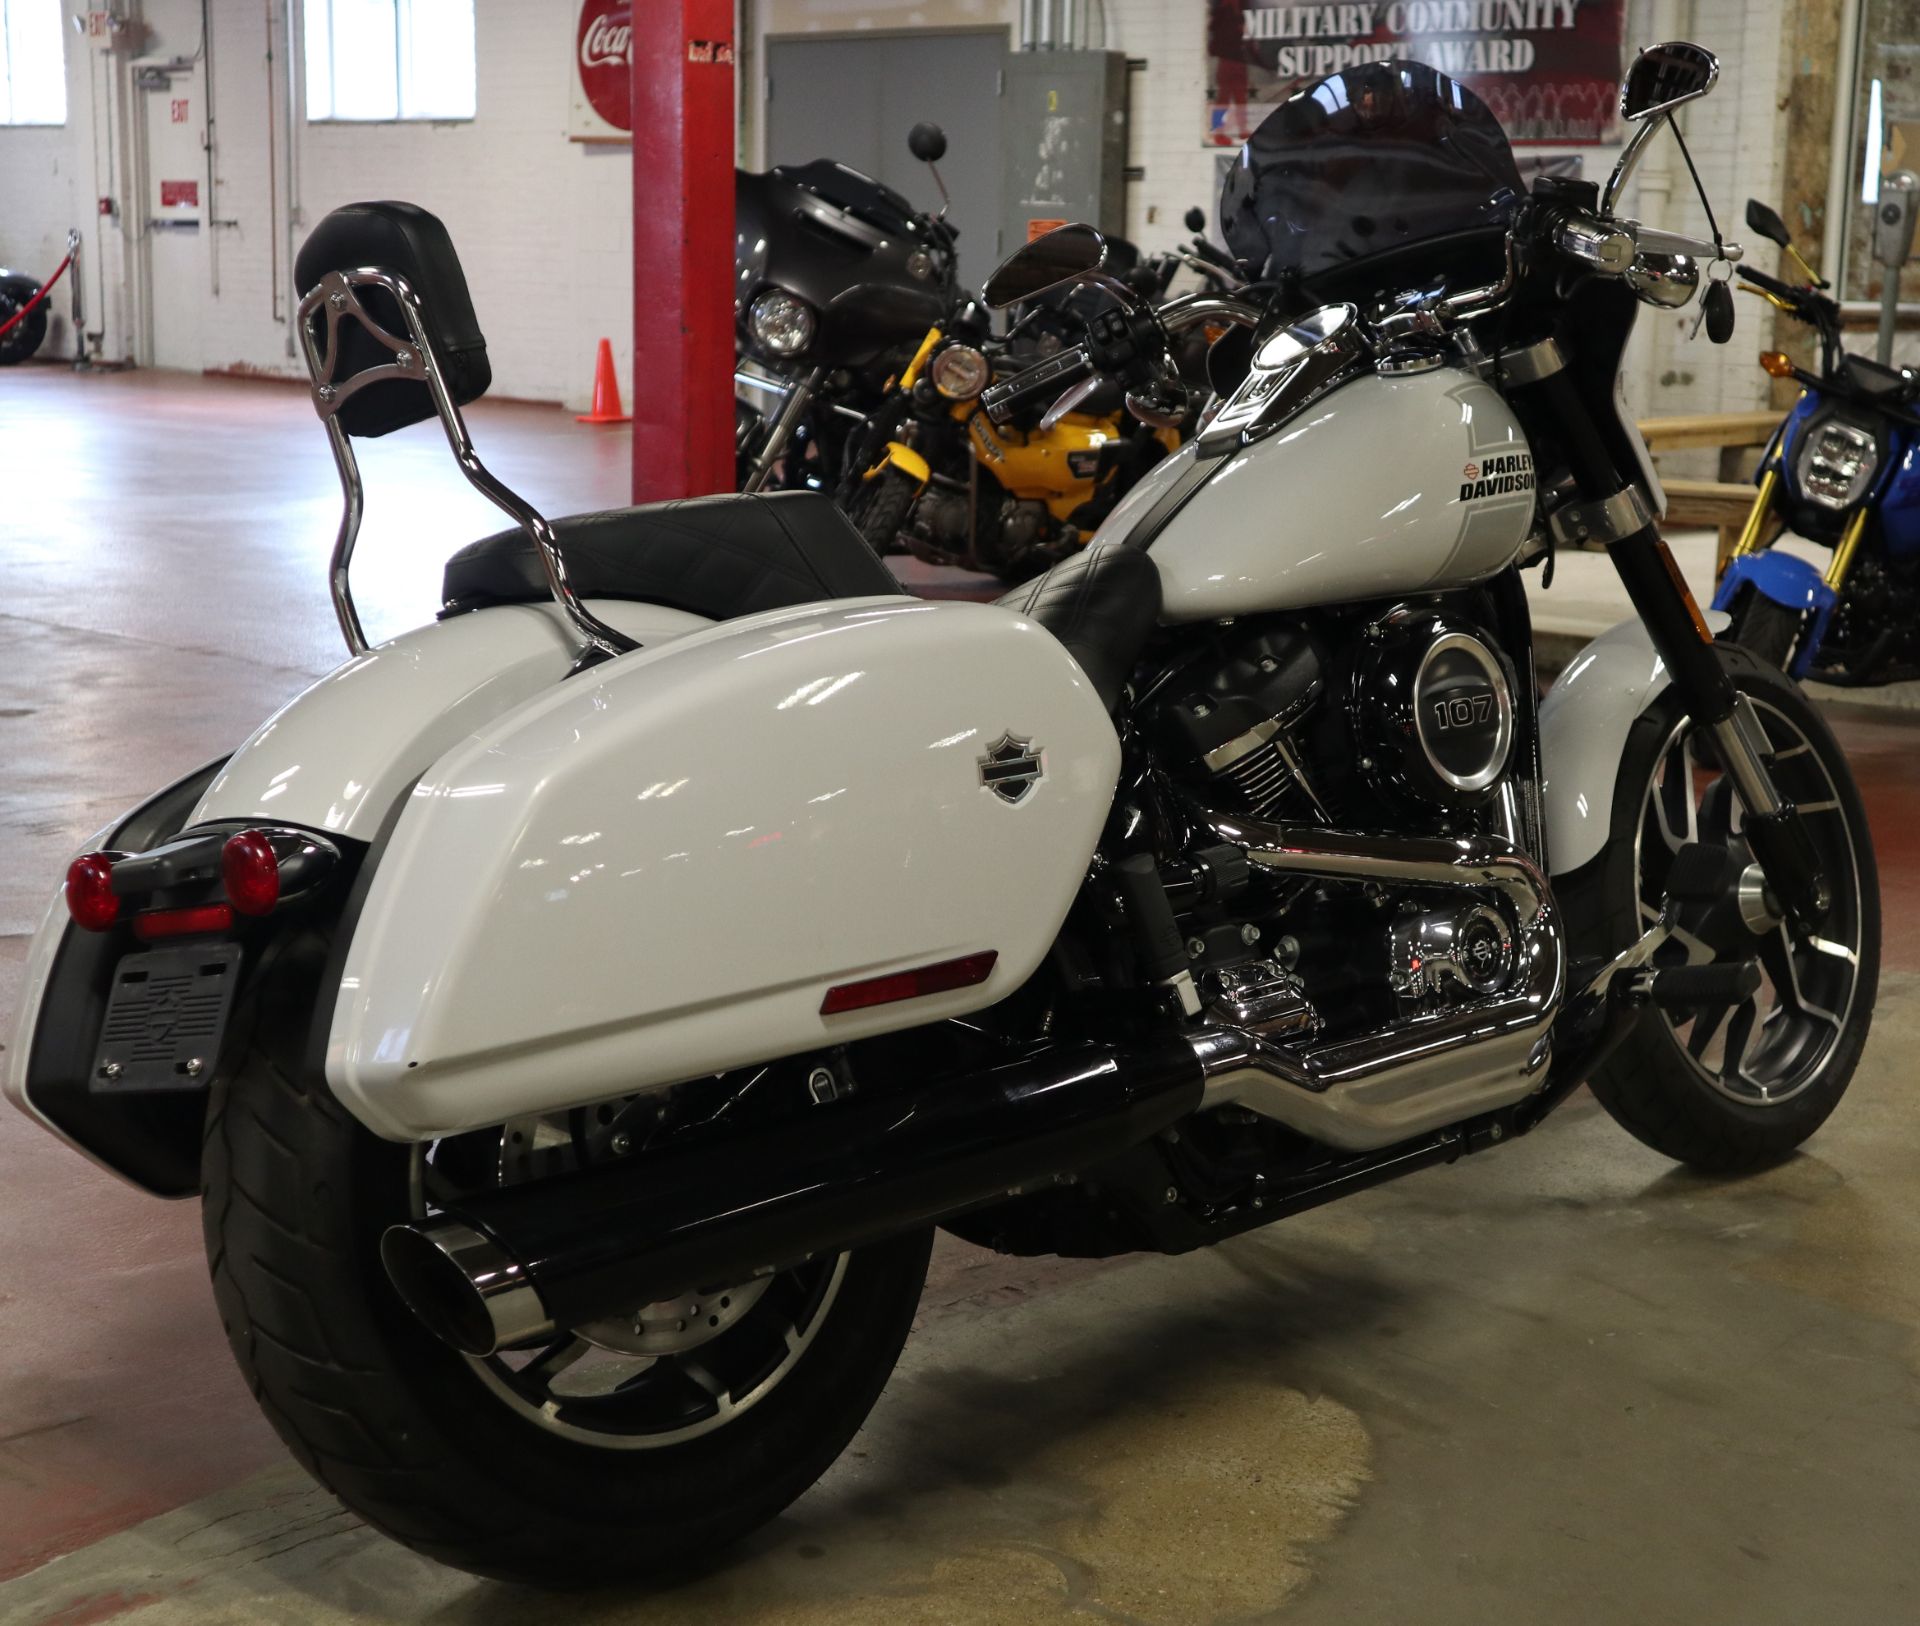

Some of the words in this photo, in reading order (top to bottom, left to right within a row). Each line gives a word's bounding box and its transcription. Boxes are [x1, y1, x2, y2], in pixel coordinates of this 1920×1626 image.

[90, 12, 107, 37] EXIT
[1242, 3, 1377, 40] MILITARY
[1386, 0, 1580, 34] COMMUNITY
[1277, 42, 1410, 77] SUPPORT
[1426, 39, 1535, 73] AWARD
[171, 99, 190, 123] EXIT
[1459, 473, 1536, 502] DAVIDSON
[1434, 694, 1493, 730] 107
